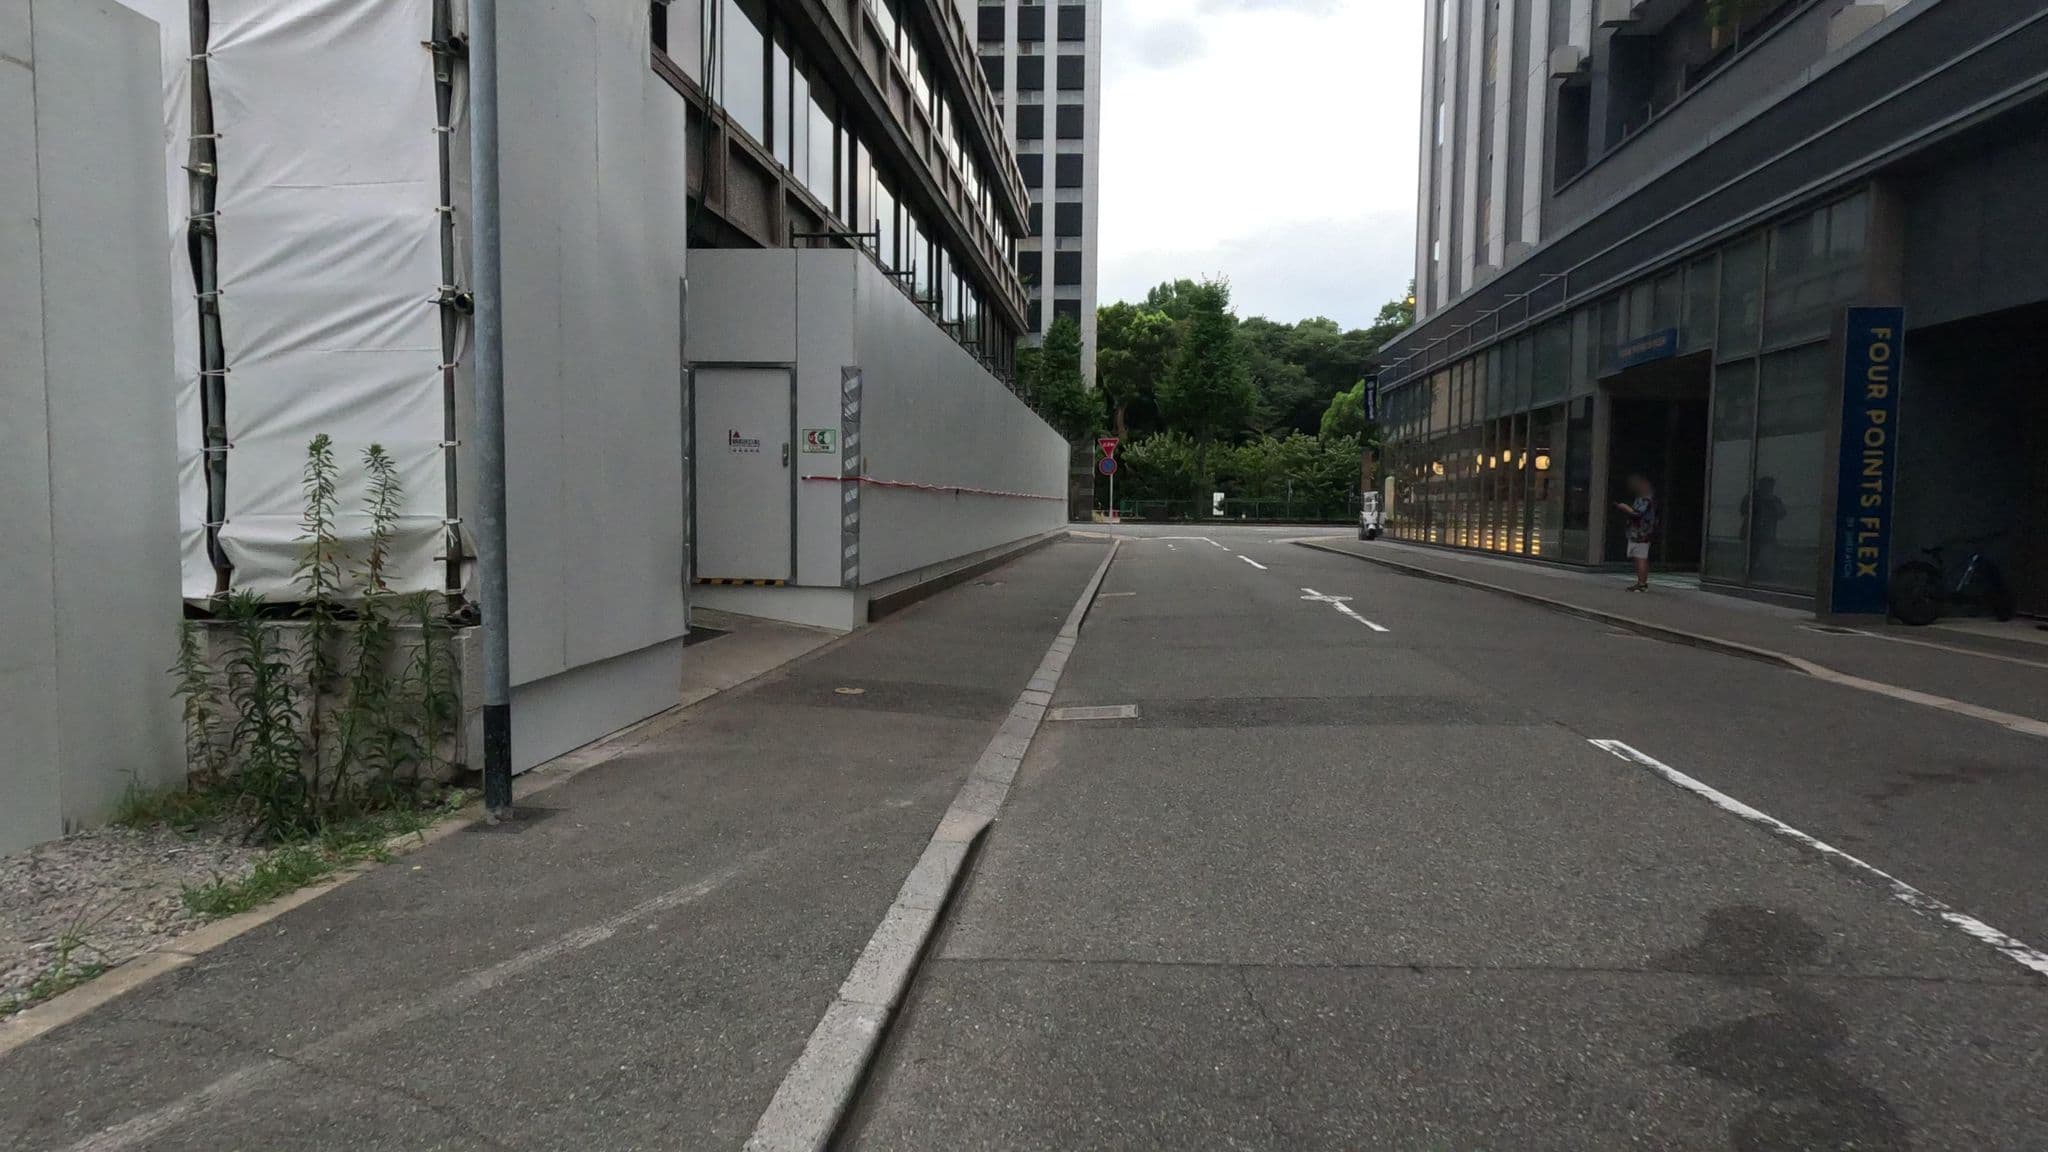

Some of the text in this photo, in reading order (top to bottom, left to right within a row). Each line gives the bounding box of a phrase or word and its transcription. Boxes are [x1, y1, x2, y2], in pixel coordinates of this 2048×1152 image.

[1856, 327, 1892, 577] FOUR POINTS FLEX
